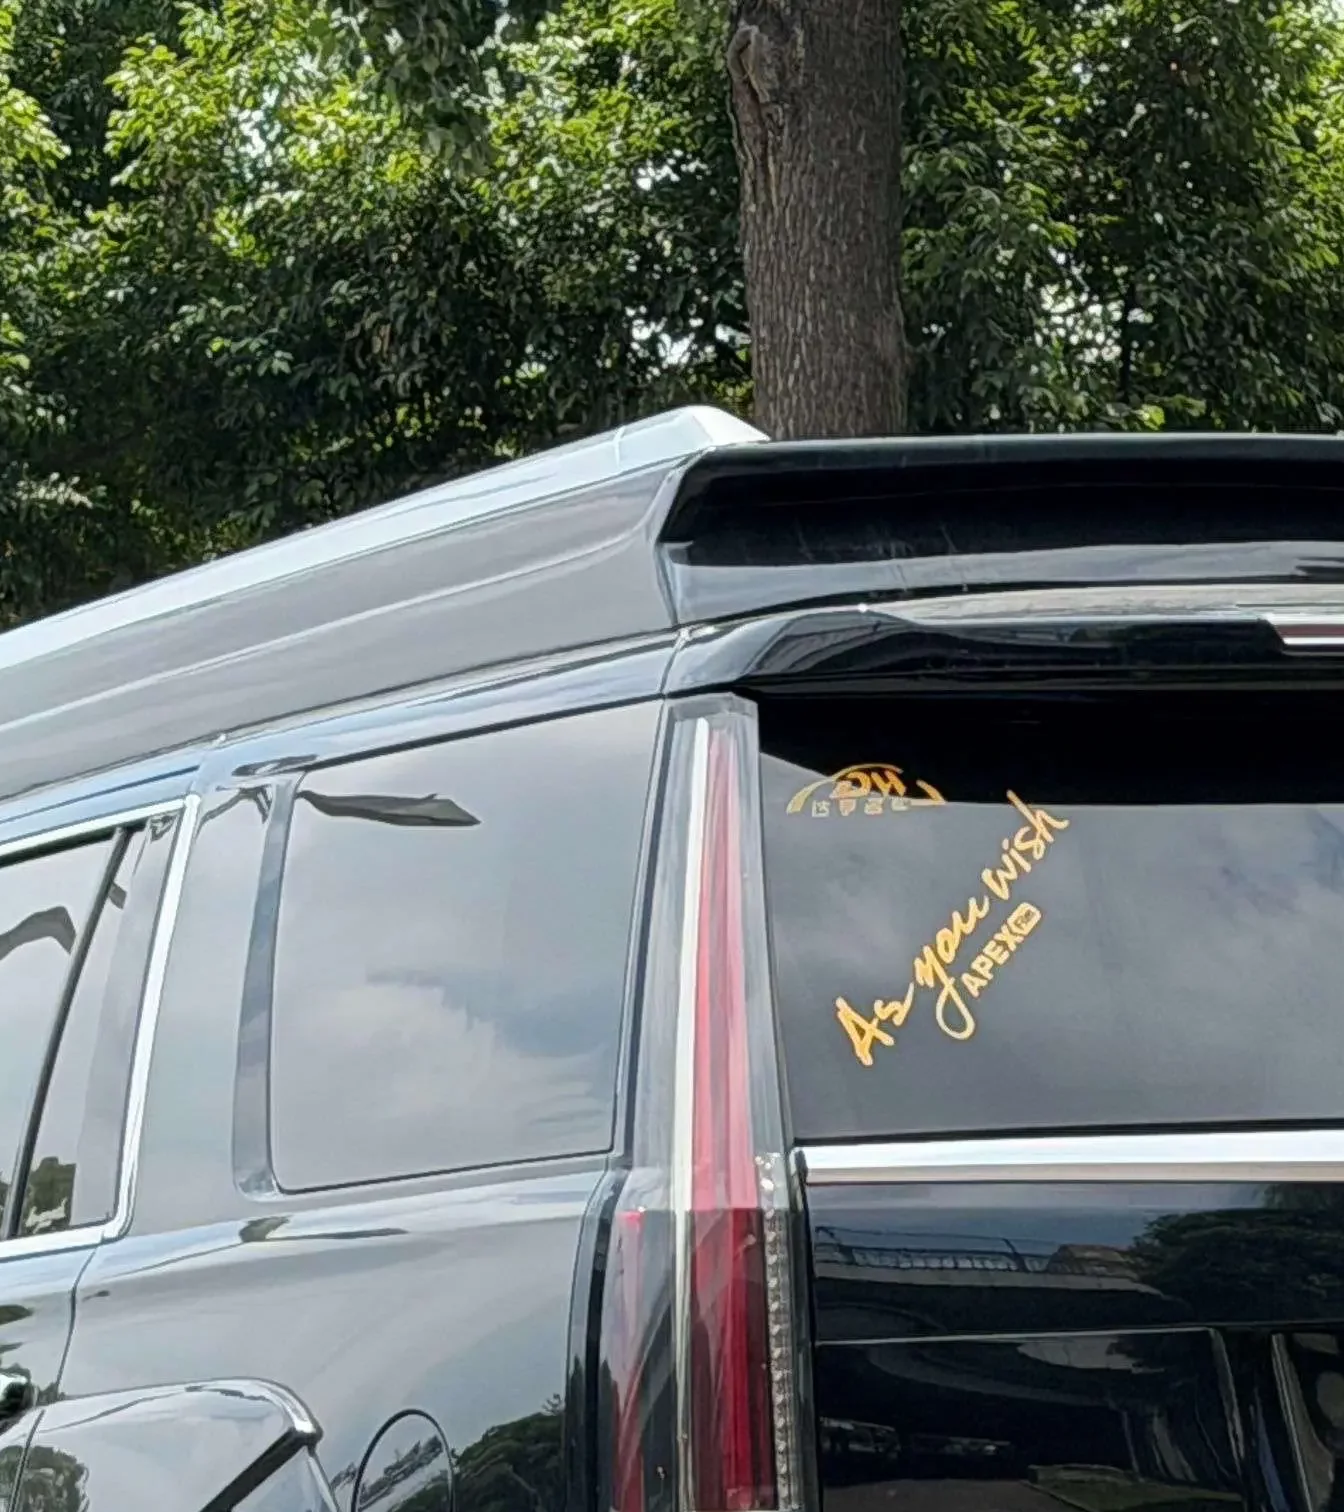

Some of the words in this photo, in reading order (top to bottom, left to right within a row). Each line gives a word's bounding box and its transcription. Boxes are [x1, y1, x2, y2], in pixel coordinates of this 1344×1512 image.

[835, 982, 914, 1066] As
[914, 896, 990, 1040] you
[981, 788, 1070, 900] wish
[961, 922, 1024, 998] APEX
